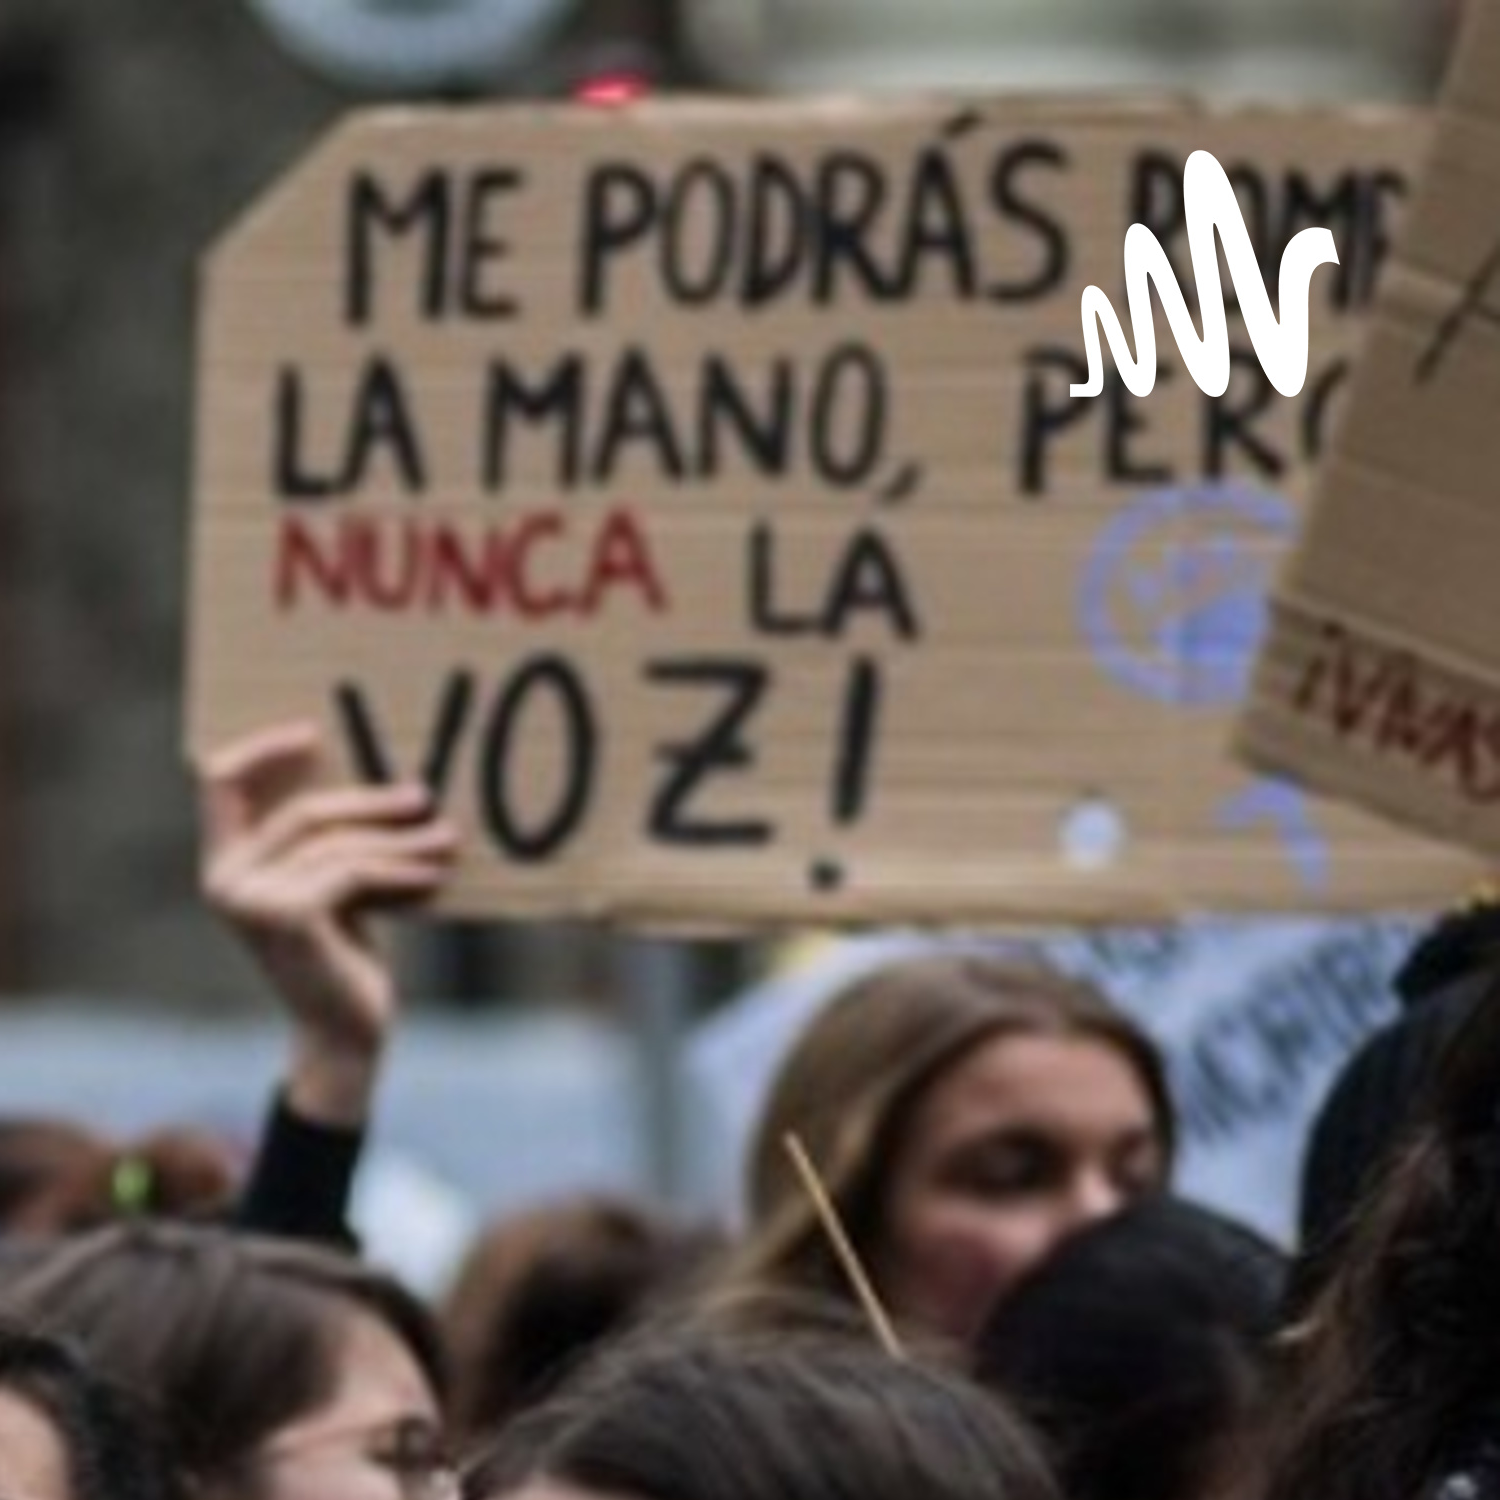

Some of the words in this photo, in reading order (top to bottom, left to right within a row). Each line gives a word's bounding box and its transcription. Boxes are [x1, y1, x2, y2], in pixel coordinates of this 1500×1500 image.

[343, 164, 524, 328] ME
[580, 112, 1073, 316] PODRÁS
[271, 349, 427, 500] LA
[485, 342, 920, 507] MANO,
[272, 509, 670, 618] NUNCA
[338, 653, 882, 894] VOZ!
